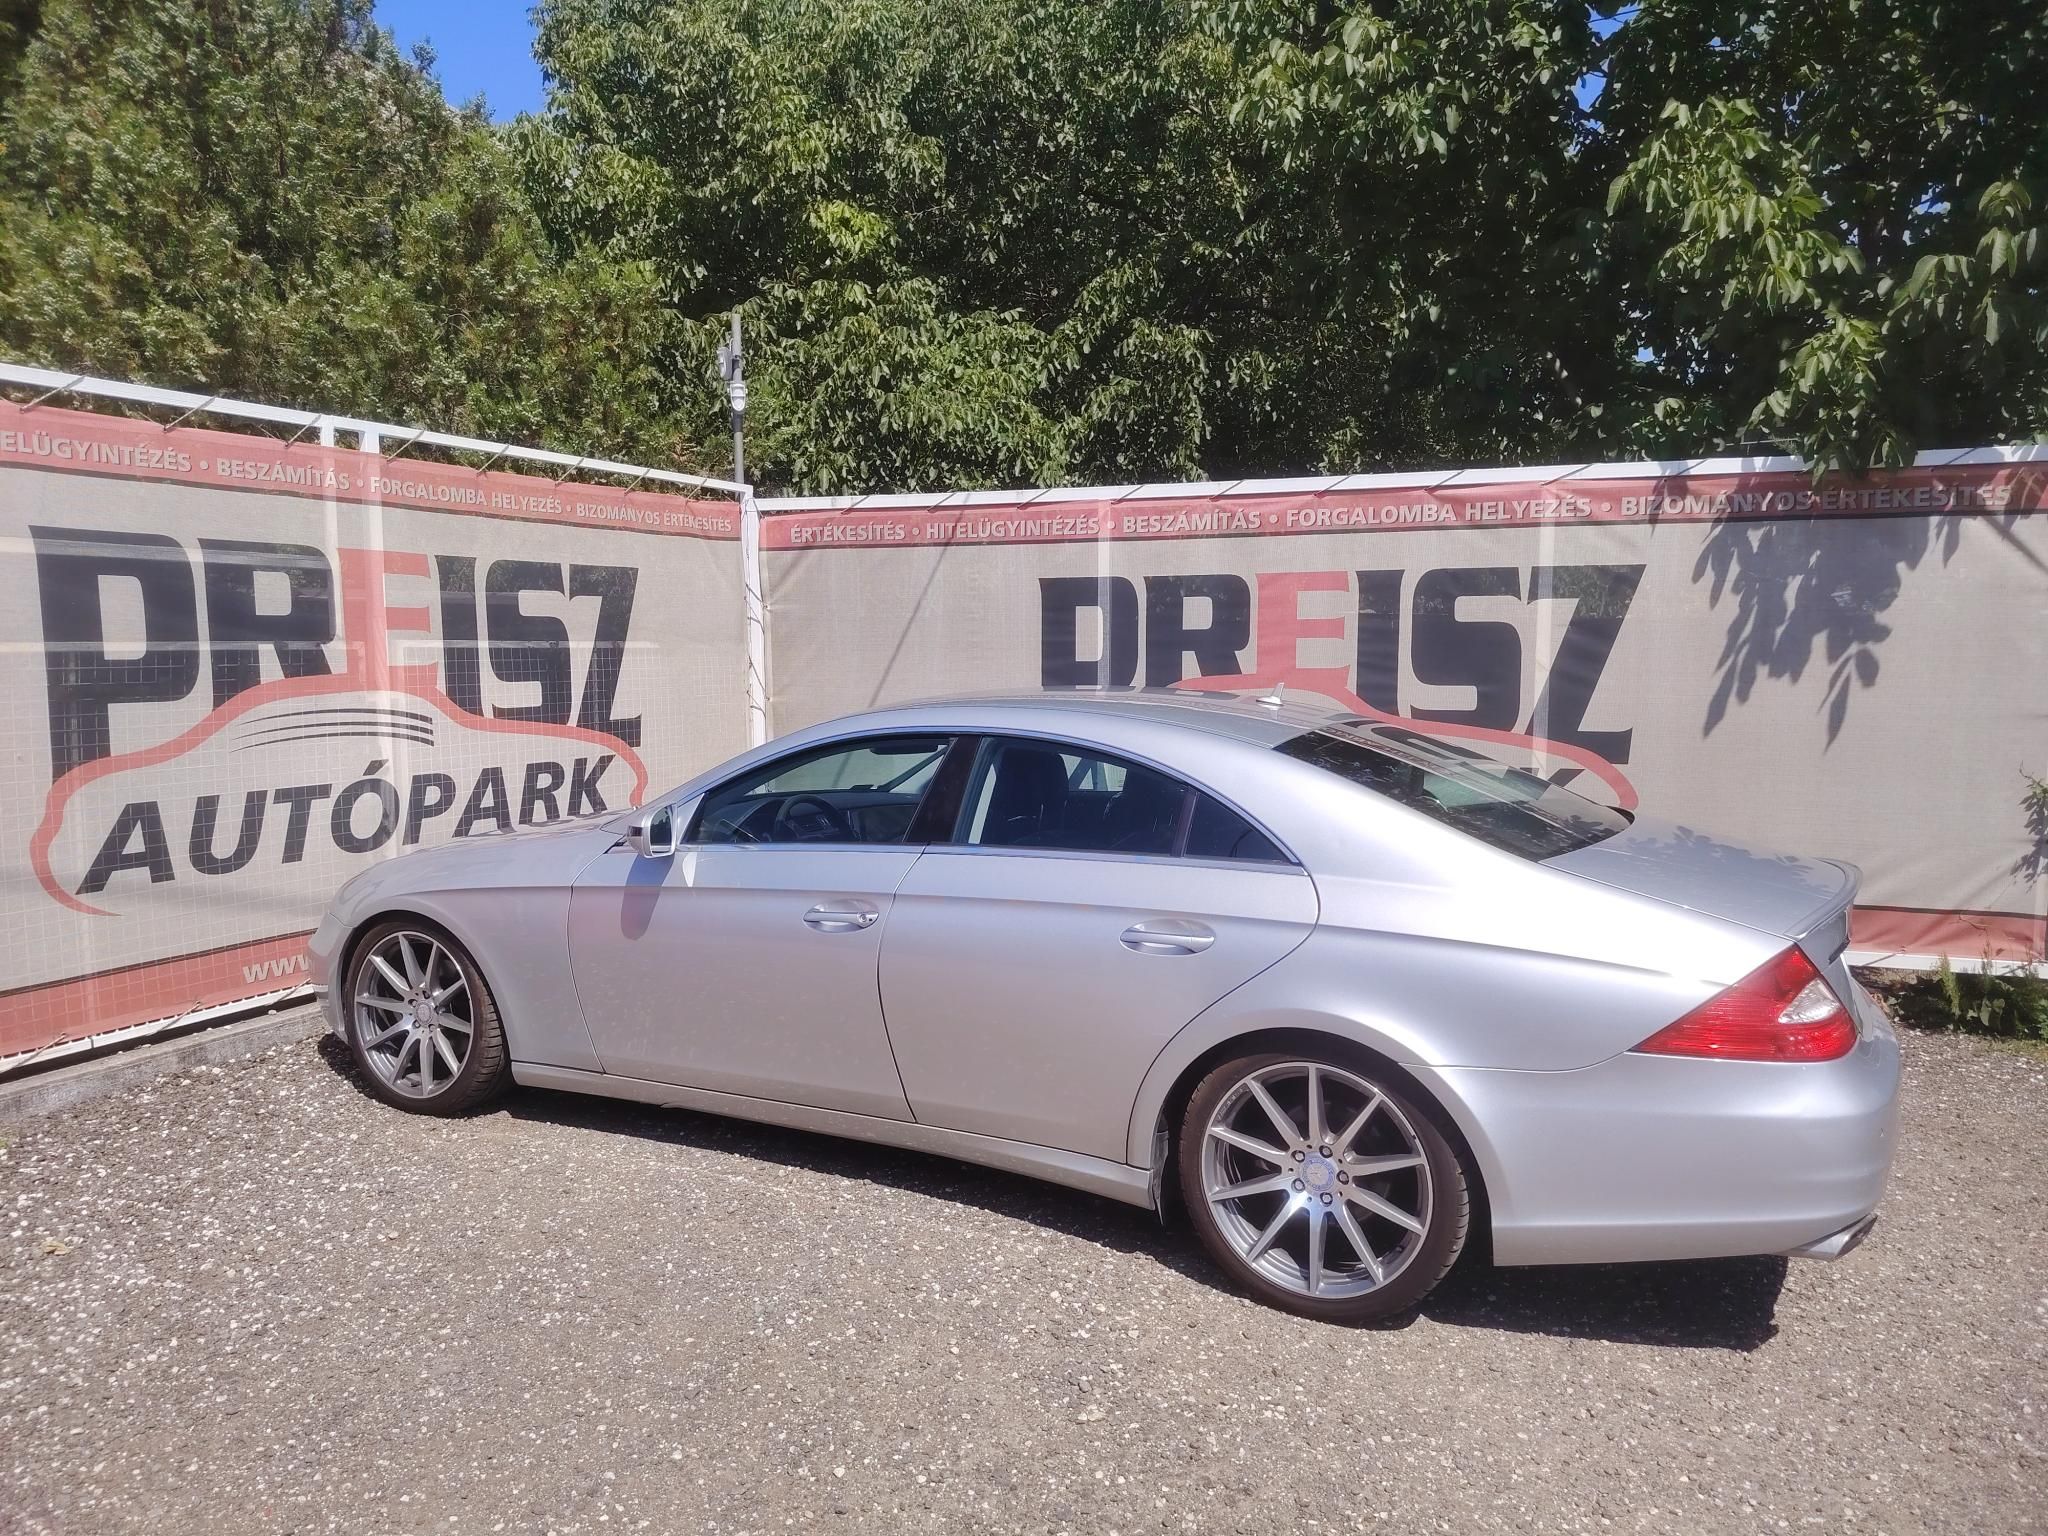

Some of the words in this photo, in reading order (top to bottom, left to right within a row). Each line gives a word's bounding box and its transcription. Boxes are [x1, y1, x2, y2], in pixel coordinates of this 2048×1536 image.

[216, 457, 350, 490] BESZÁMÍTÁS
[369, 477, 487, 505] FORGALOMBA
[492, 492, 562, 514] HELYEZÉS
[576, 503, 660, 526] BIZOMÁNYOS
[790, 523, 905, 543] ÉRTÉKESÍTÉS
[926, 515, 1100, 539] HITELÜGYINTÉZÉS
[1123, 509, 1261, 533] BESZÁMÍTÁS
[1286, 503, 1457, 527] FORGALOMBA
[1465, 496, 1592, 522] HELYEZÉS
[1621, 489, 1813, 516] BIZOMÁNYOS
[1822, 480, 2012, 511] ÉRTÉKESÍTÉS
[28, 525, 641, 786] PREISZ
[75, 755, 616, 895] AUTÓPARK
